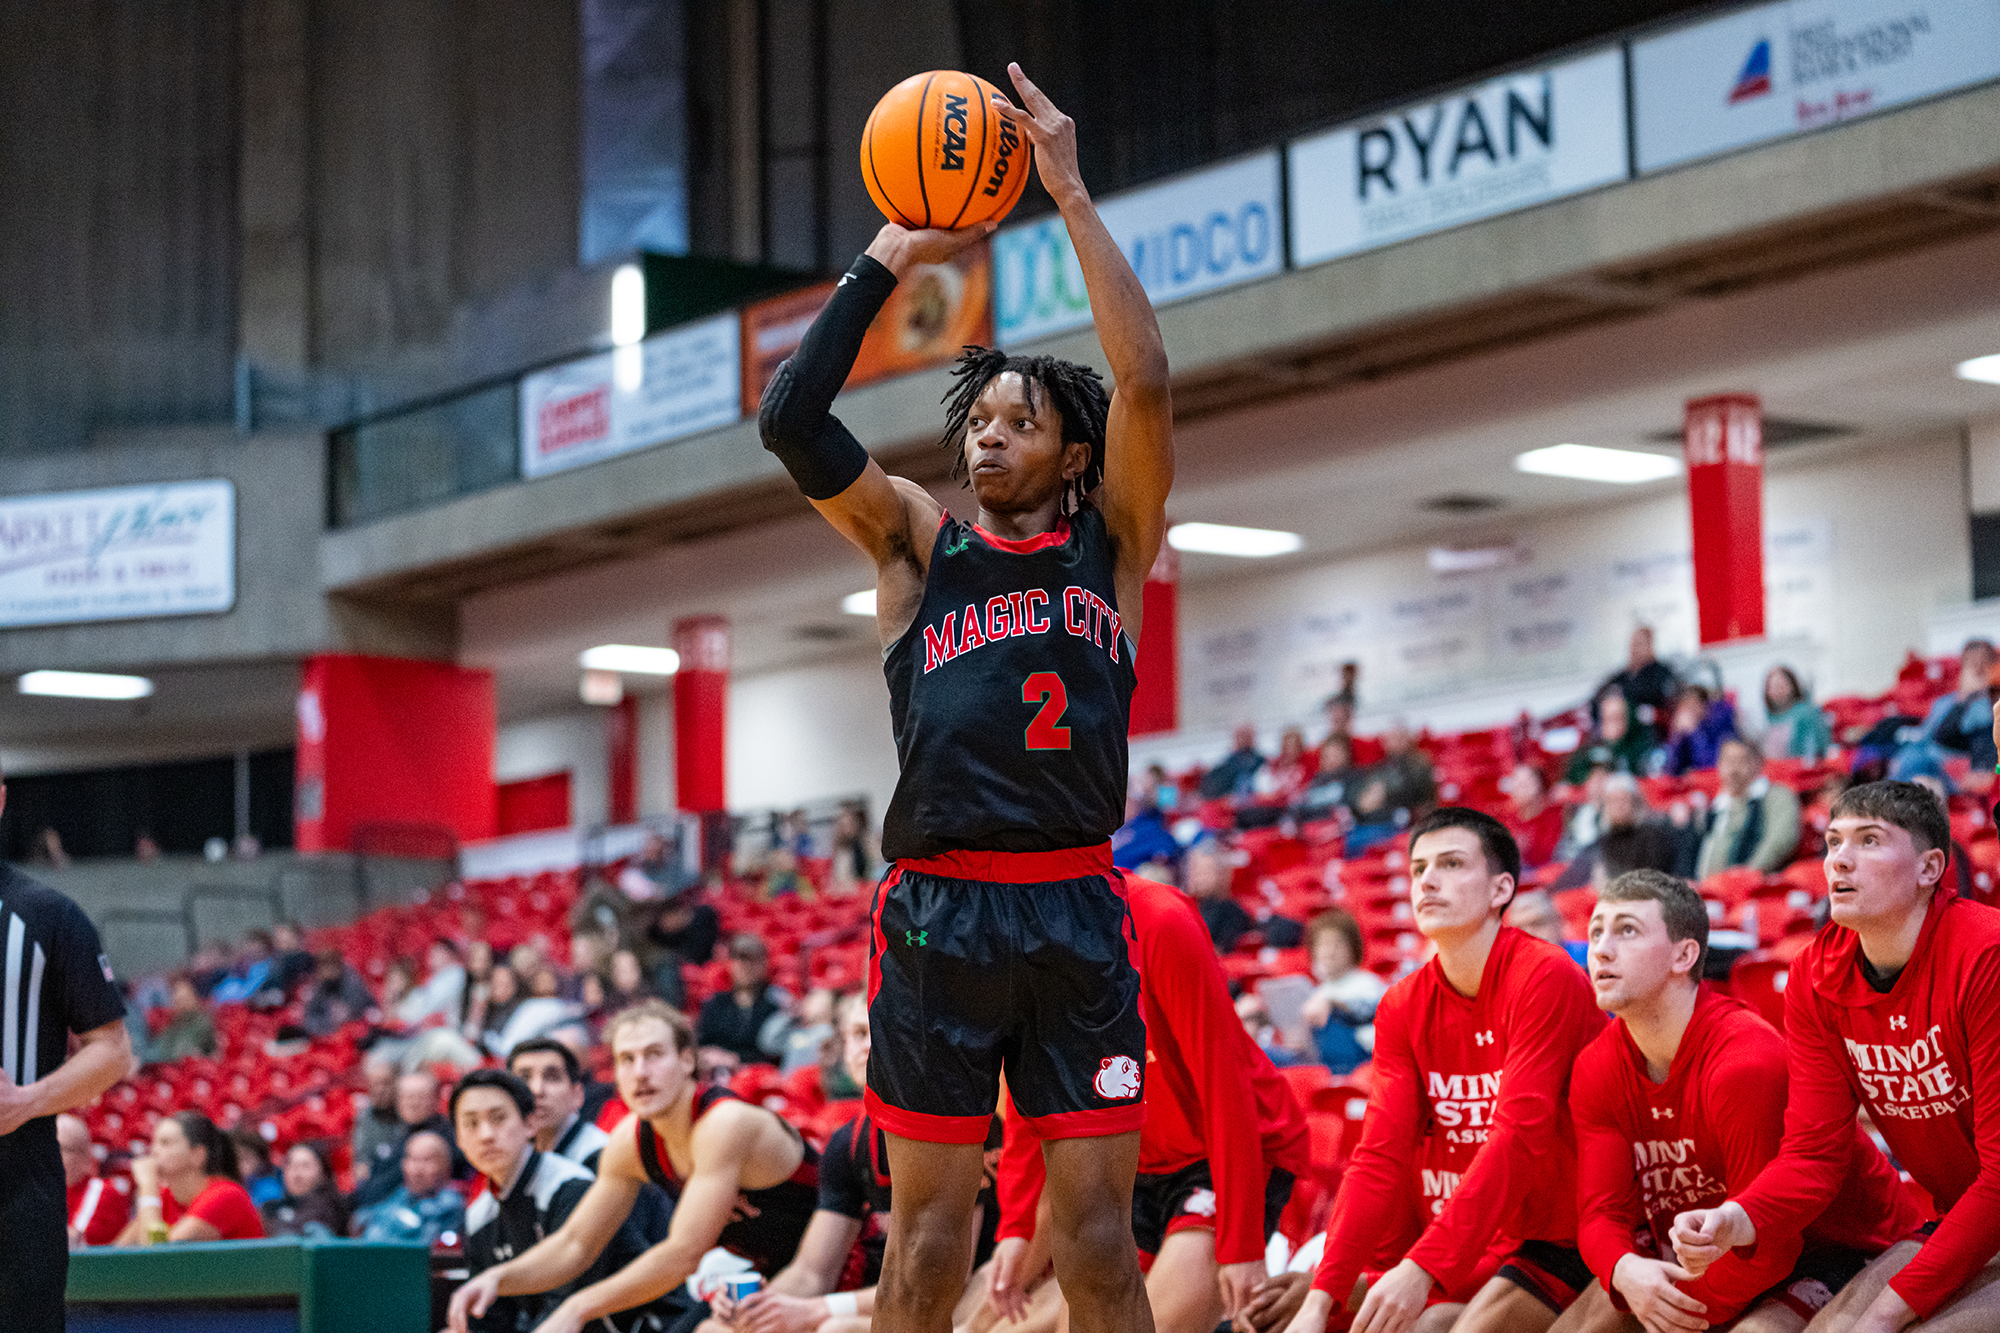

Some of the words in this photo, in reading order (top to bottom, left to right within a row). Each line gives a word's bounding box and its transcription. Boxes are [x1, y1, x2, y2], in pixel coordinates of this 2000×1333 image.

[940, 93, 968, 171] NCAA
[1357, 68, 1553, 200] RYAN
[923, 588, 1051, 675] MAGIC
[1062, 586, 1123, 665] CITY
[1021, 671, 1071, 750] 2
[1844, 1024, 1944, 1072] MINOT
[1858, 1061, 1957, 1102] STATE
